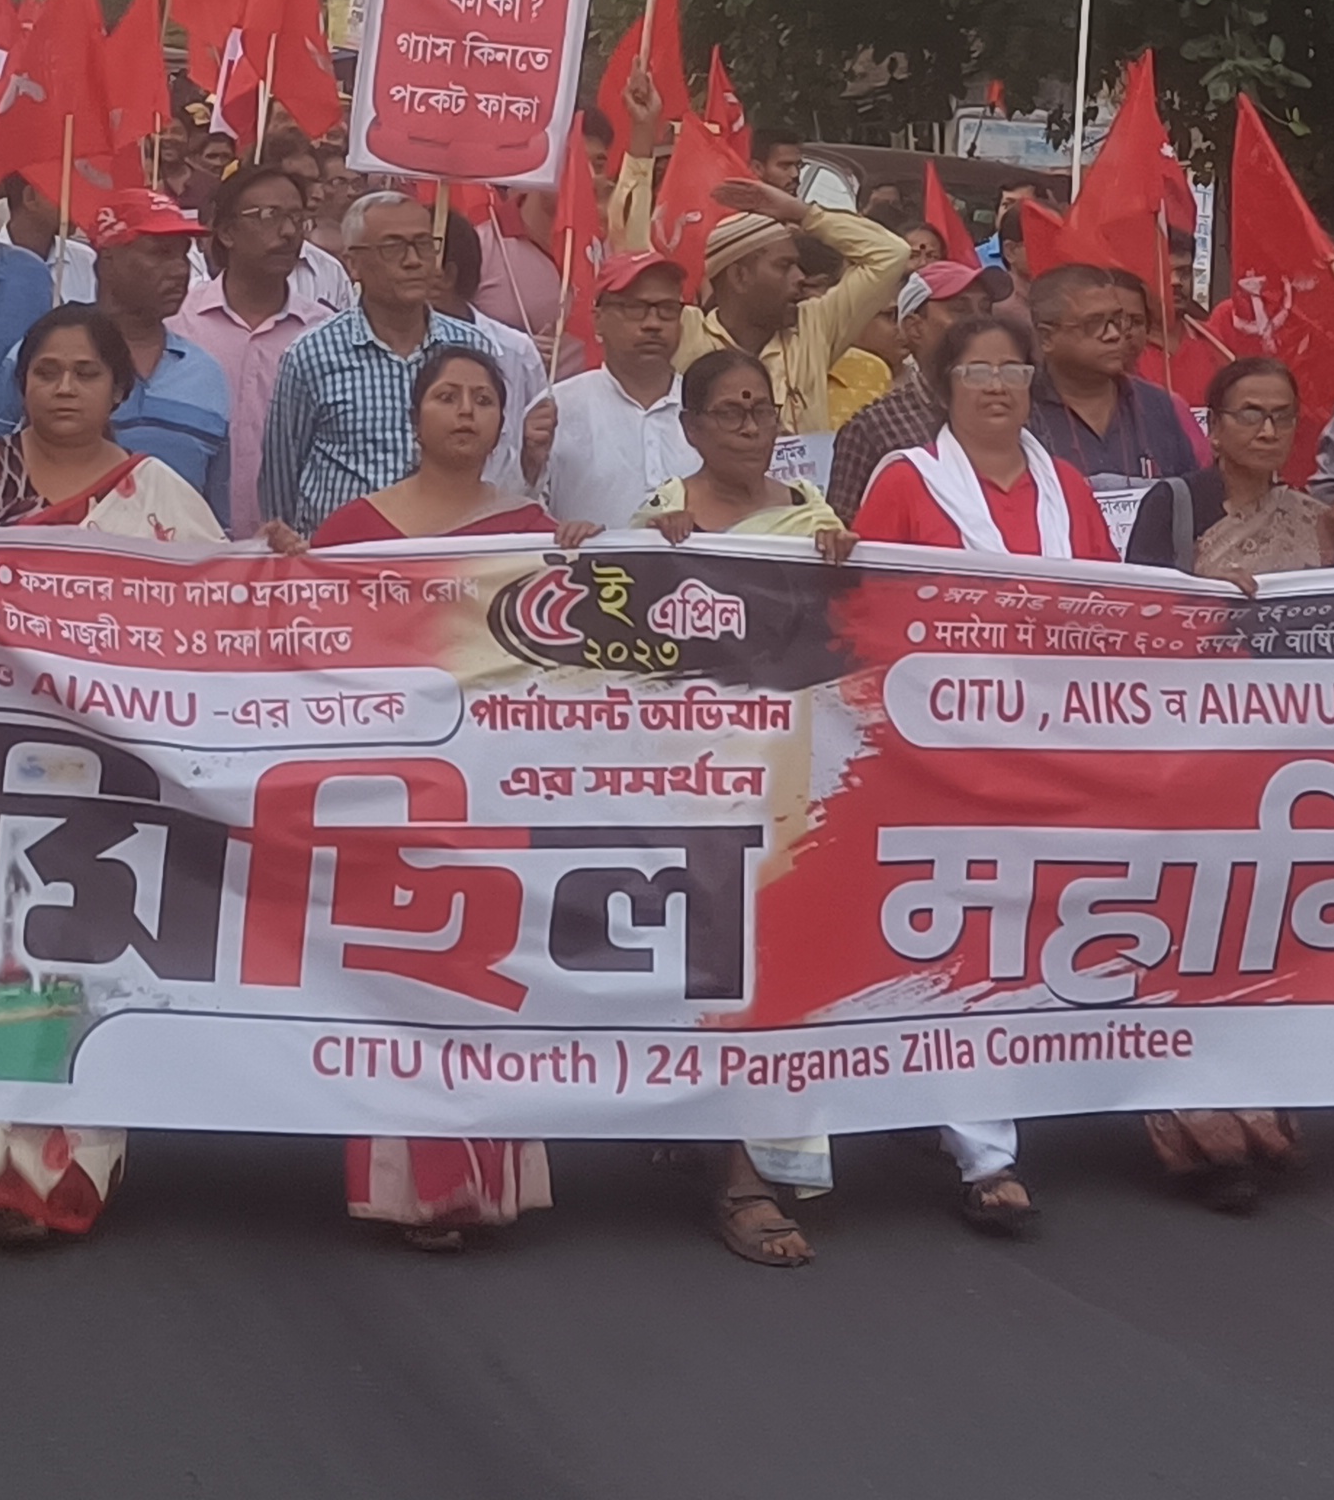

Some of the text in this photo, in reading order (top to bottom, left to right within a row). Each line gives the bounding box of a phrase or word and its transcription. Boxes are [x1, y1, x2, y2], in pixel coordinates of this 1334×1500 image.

[396, 32, 553, 73] গ্যাস কিনতে
[389, 82, 469, 115] পকেট
[16, 569, 113, 601] ফসলের
[184, 580, 231, 607] দাম
[357, 570, 412, 612] বৃদ্ধি
[649, 579, 745, 639] এপ্রিল
[994, 584, 1052, 611] कोड
[2, 600, 52, 641] টাকা
[126, 625, 165, 657] সহ
[173, 628, 208, 655] ১৪
[215, 625, 262, 658] দফা
[267, 616, 353, 657] দাবিতে
[933, 613, 1007, 649] मनरेगा
[1015, 616, 1037, 649] में
[1045, 620, 1129, 654] प्रतिदिन
[1134, 631, 1184, 654] ६००
[583, 638, 680, 671] ২০২৩
[30, 671, 197, 728] AIAWU
[301, 690, 406, 728] ডাকে
[470, 683, 792, 731] পার্লামেন্ট অভিযান
[1063, 680, 1152, 726] AIKS
[1160, 688, 1188, 725] व
[500, 751, 765, 801] এর সমর্থনে
[312, 1036, 422, 1079] CITU
[645, 1044, 702, 1085] 24
[720, 1043, 890, 1093] Parganas
[900, 1029, 975, 1073] Zilla
[986, 1020, 1194, 1067] Committee
